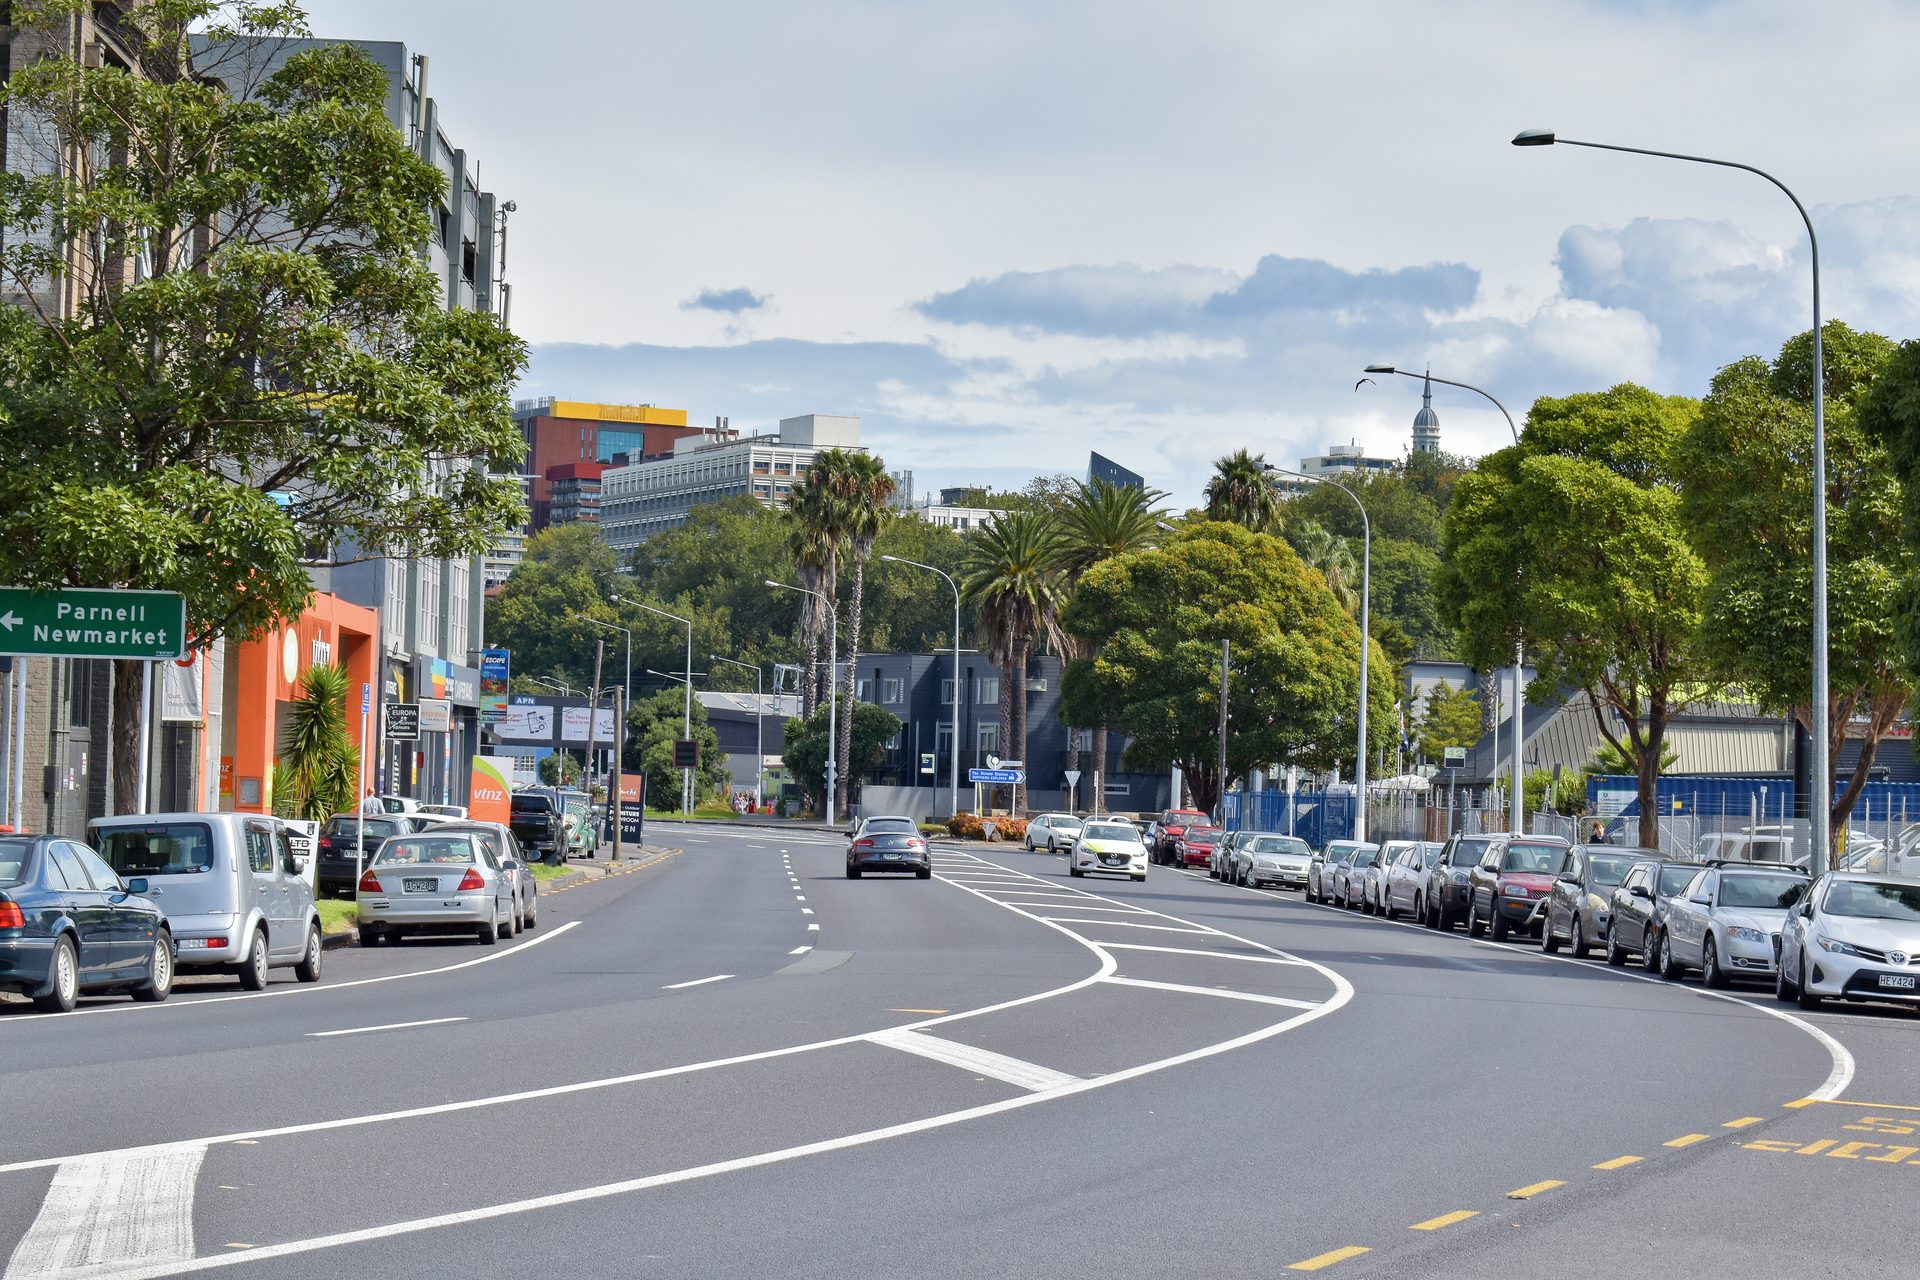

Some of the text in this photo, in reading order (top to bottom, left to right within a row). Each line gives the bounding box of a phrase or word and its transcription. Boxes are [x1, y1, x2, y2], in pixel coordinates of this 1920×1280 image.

[57, 603, 145, 621] Parnell
[33, 624, 167, 645] Newmarket
[1447, 750, 1464, 758] 42
[473, 787, 502, 801] vtnz
[1880, 975, 1914, 988] HEY424
